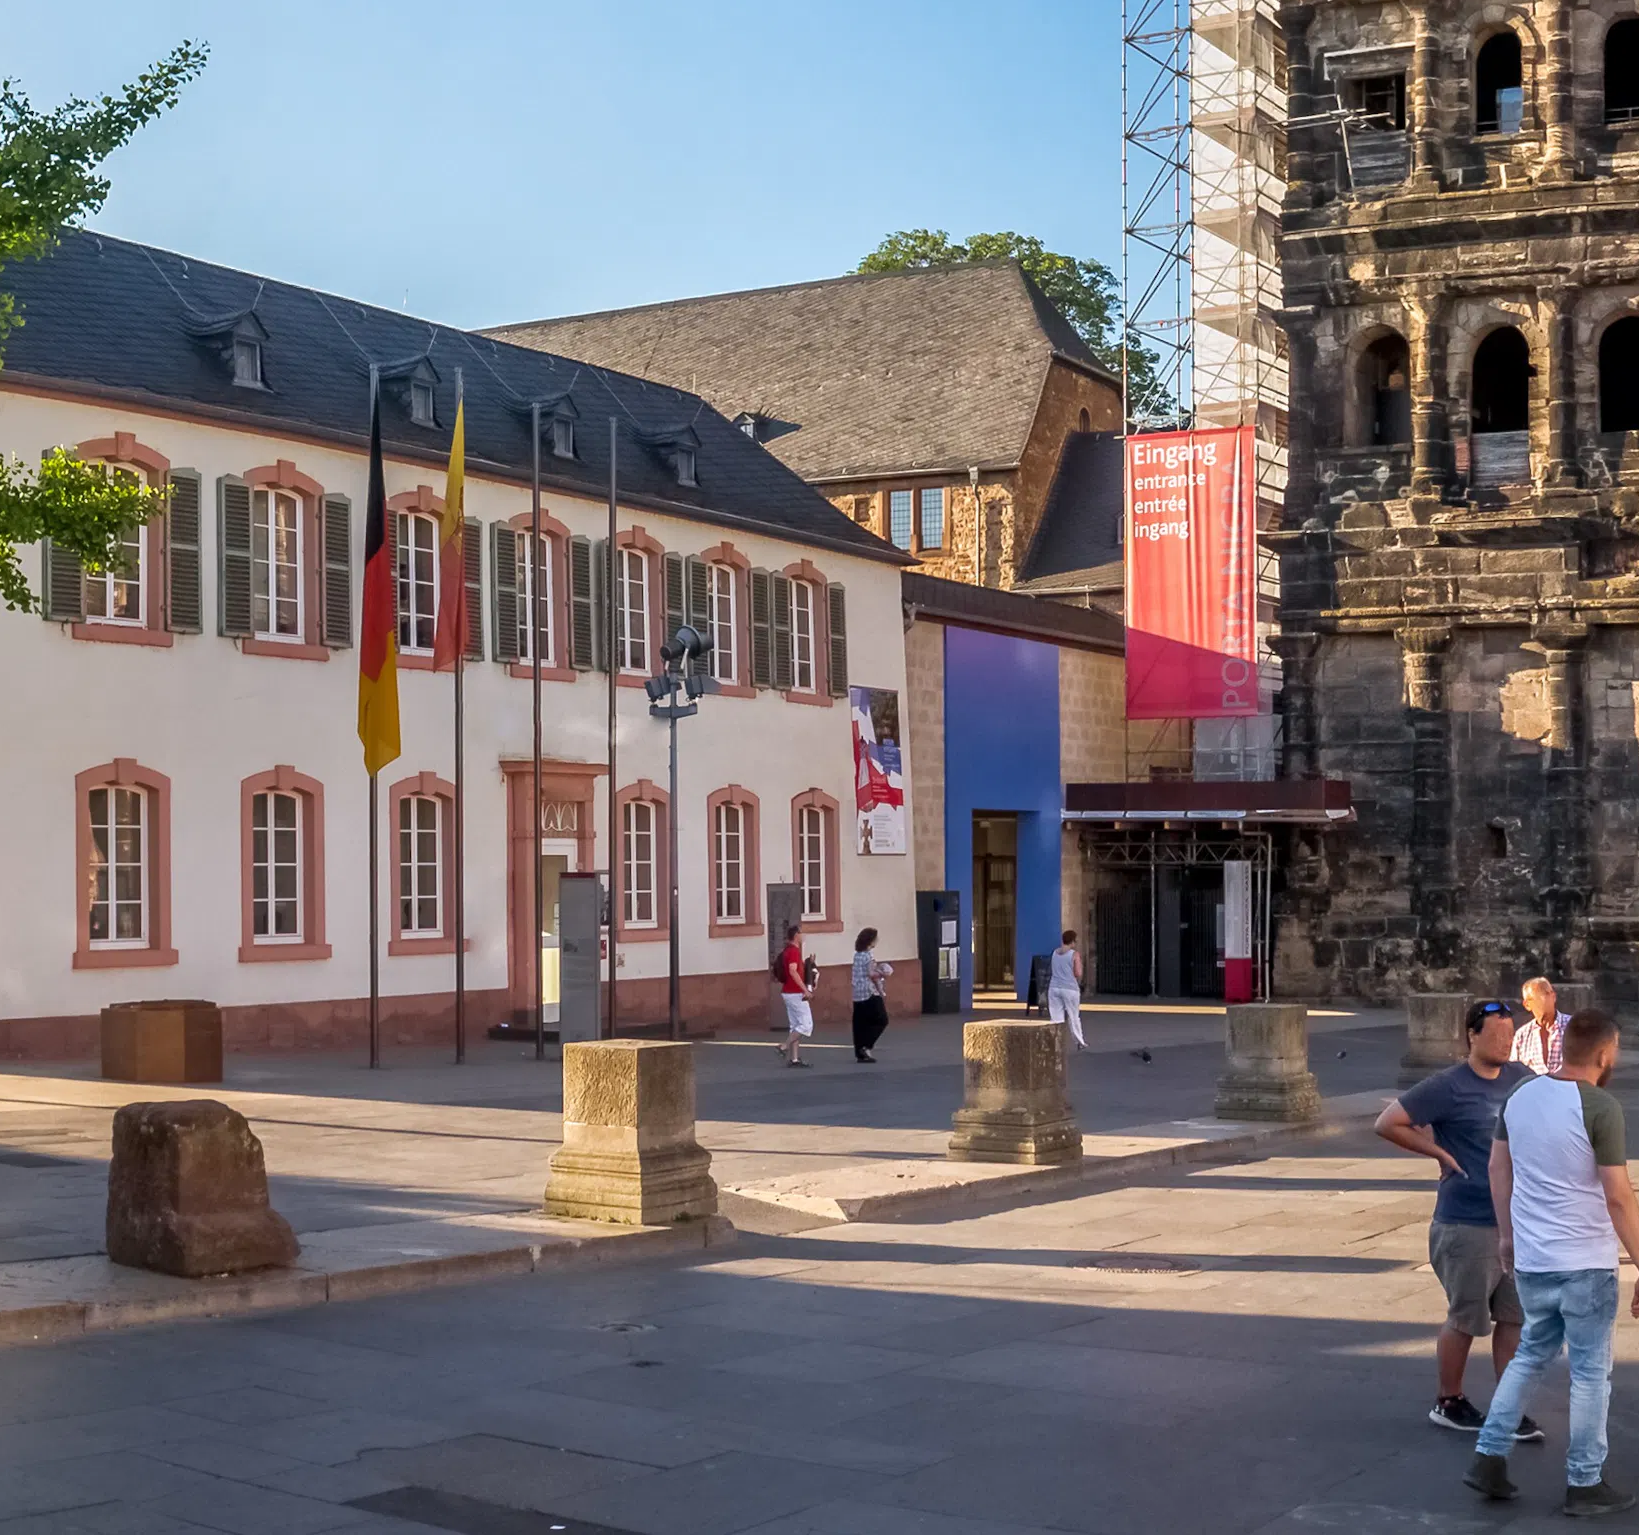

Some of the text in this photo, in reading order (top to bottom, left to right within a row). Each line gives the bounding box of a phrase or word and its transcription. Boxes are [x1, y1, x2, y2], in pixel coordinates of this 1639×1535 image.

[1134, 442, 1217, 469] Eingang
[1134, 472, 1206, 491] entrance
[1134, 495, 1188, 514] entrée
[1134, 520, 1189, 541] ingang
[1222, 588, 1250, 708] PORTA
